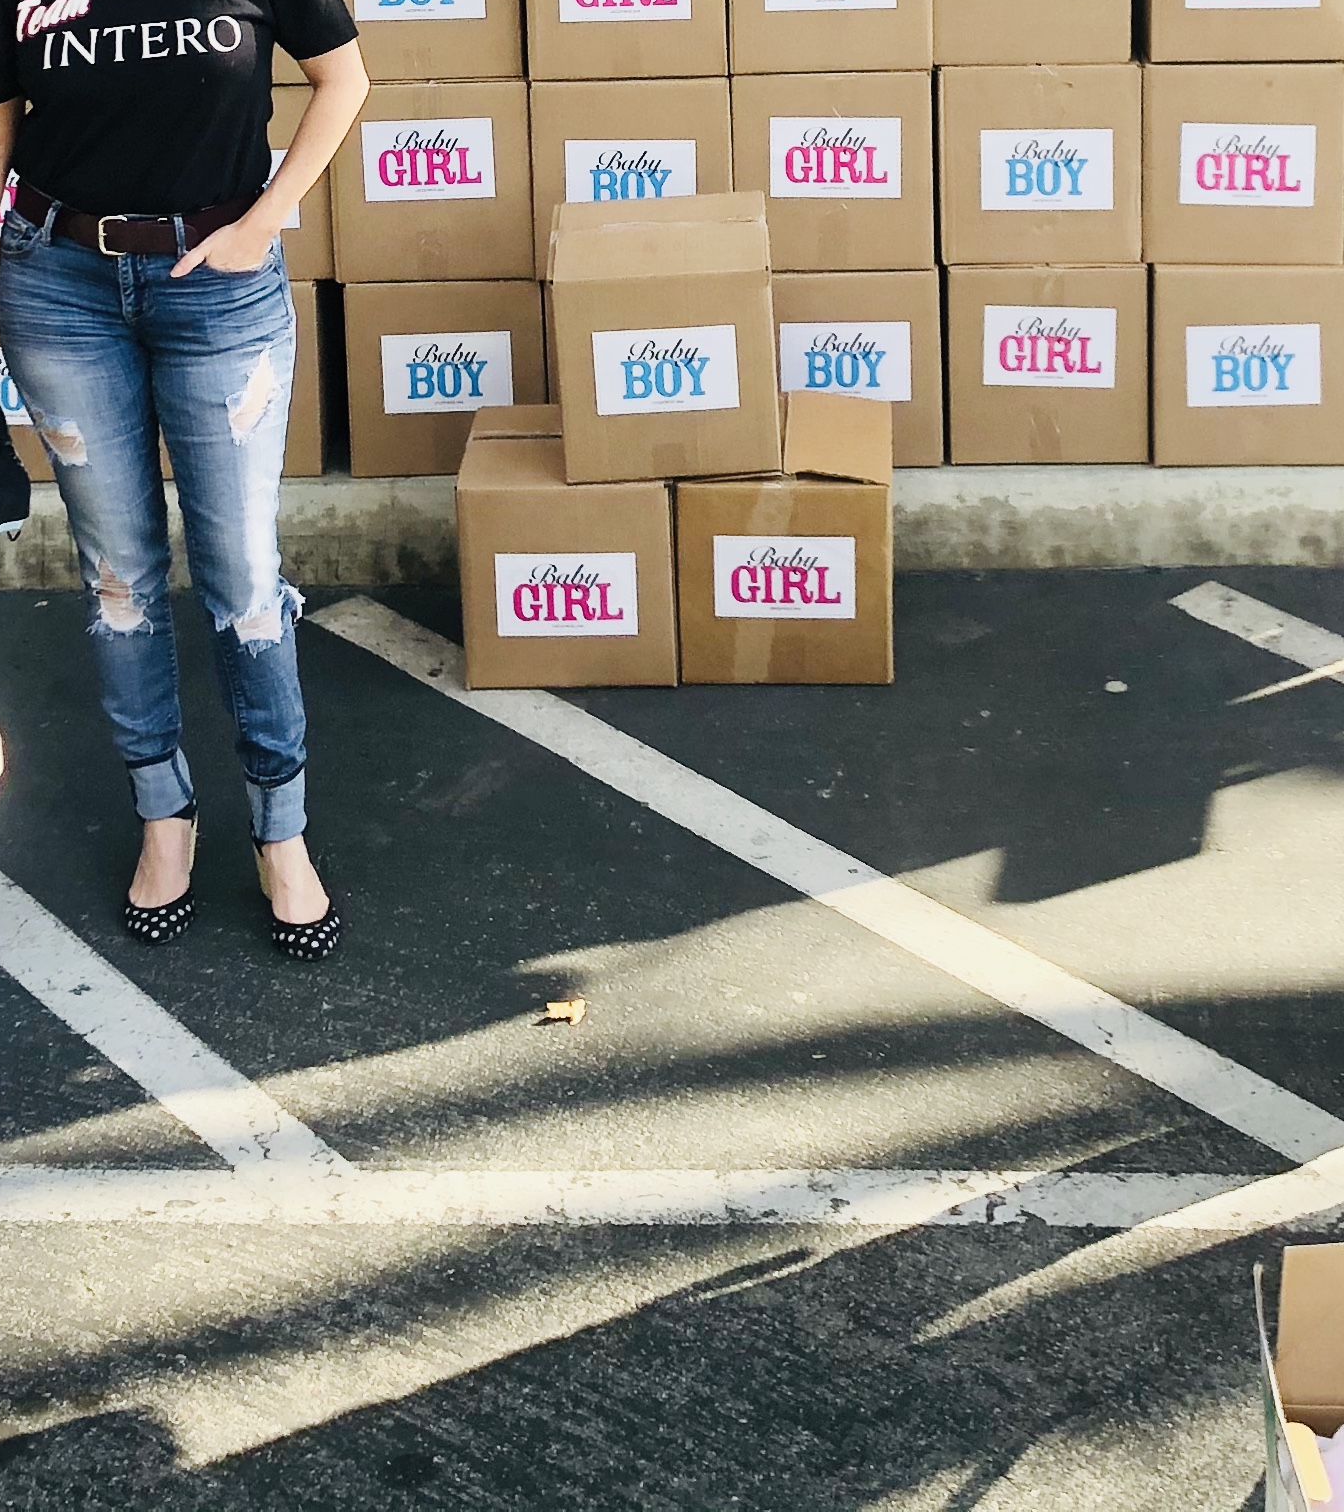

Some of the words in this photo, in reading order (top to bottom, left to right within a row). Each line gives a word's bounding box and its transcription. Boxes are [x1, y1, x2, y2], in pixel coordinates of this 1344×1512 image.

[42, 15, 243, 70] INTERO
[393, 129, 458, 156] Baby
[800, 128, 866, 154] Baby
[1012, 140, 1077, 165] Baby
[1211, 135, 1276, 162] Baby
[378, 148, 481, 187] GIRL
[596, 151, 661, 176] Baby
[785, 146, 887, 183] GIRL
[1007, 157, 1087, 196] BOY
[1196, 154, 1300, 192] GIRL
[590, 168, 672, 201] BOY
[810, 333, 876, 357] Baby
[1015, 317, 1080, 344] Baby
[412, 343, 477, 369] Baby
[627, 339, 698, 365] Baby
[1000, 336, 1100, 373] GIRL
[1218, 336, 1283, 361] Baby
[406, 361, 487, 400] BOY
[621, 357, 709, 400] BOY
[804, 349, 885, 389] BOY
[1212, 353, 1294, 392] BOY
[746, 547, 818, 574] Baby
[528, 564, 600, 592] Baby
[731, 566, 840, 604] GIRL
[513, 584, 623, 621] GIRL
